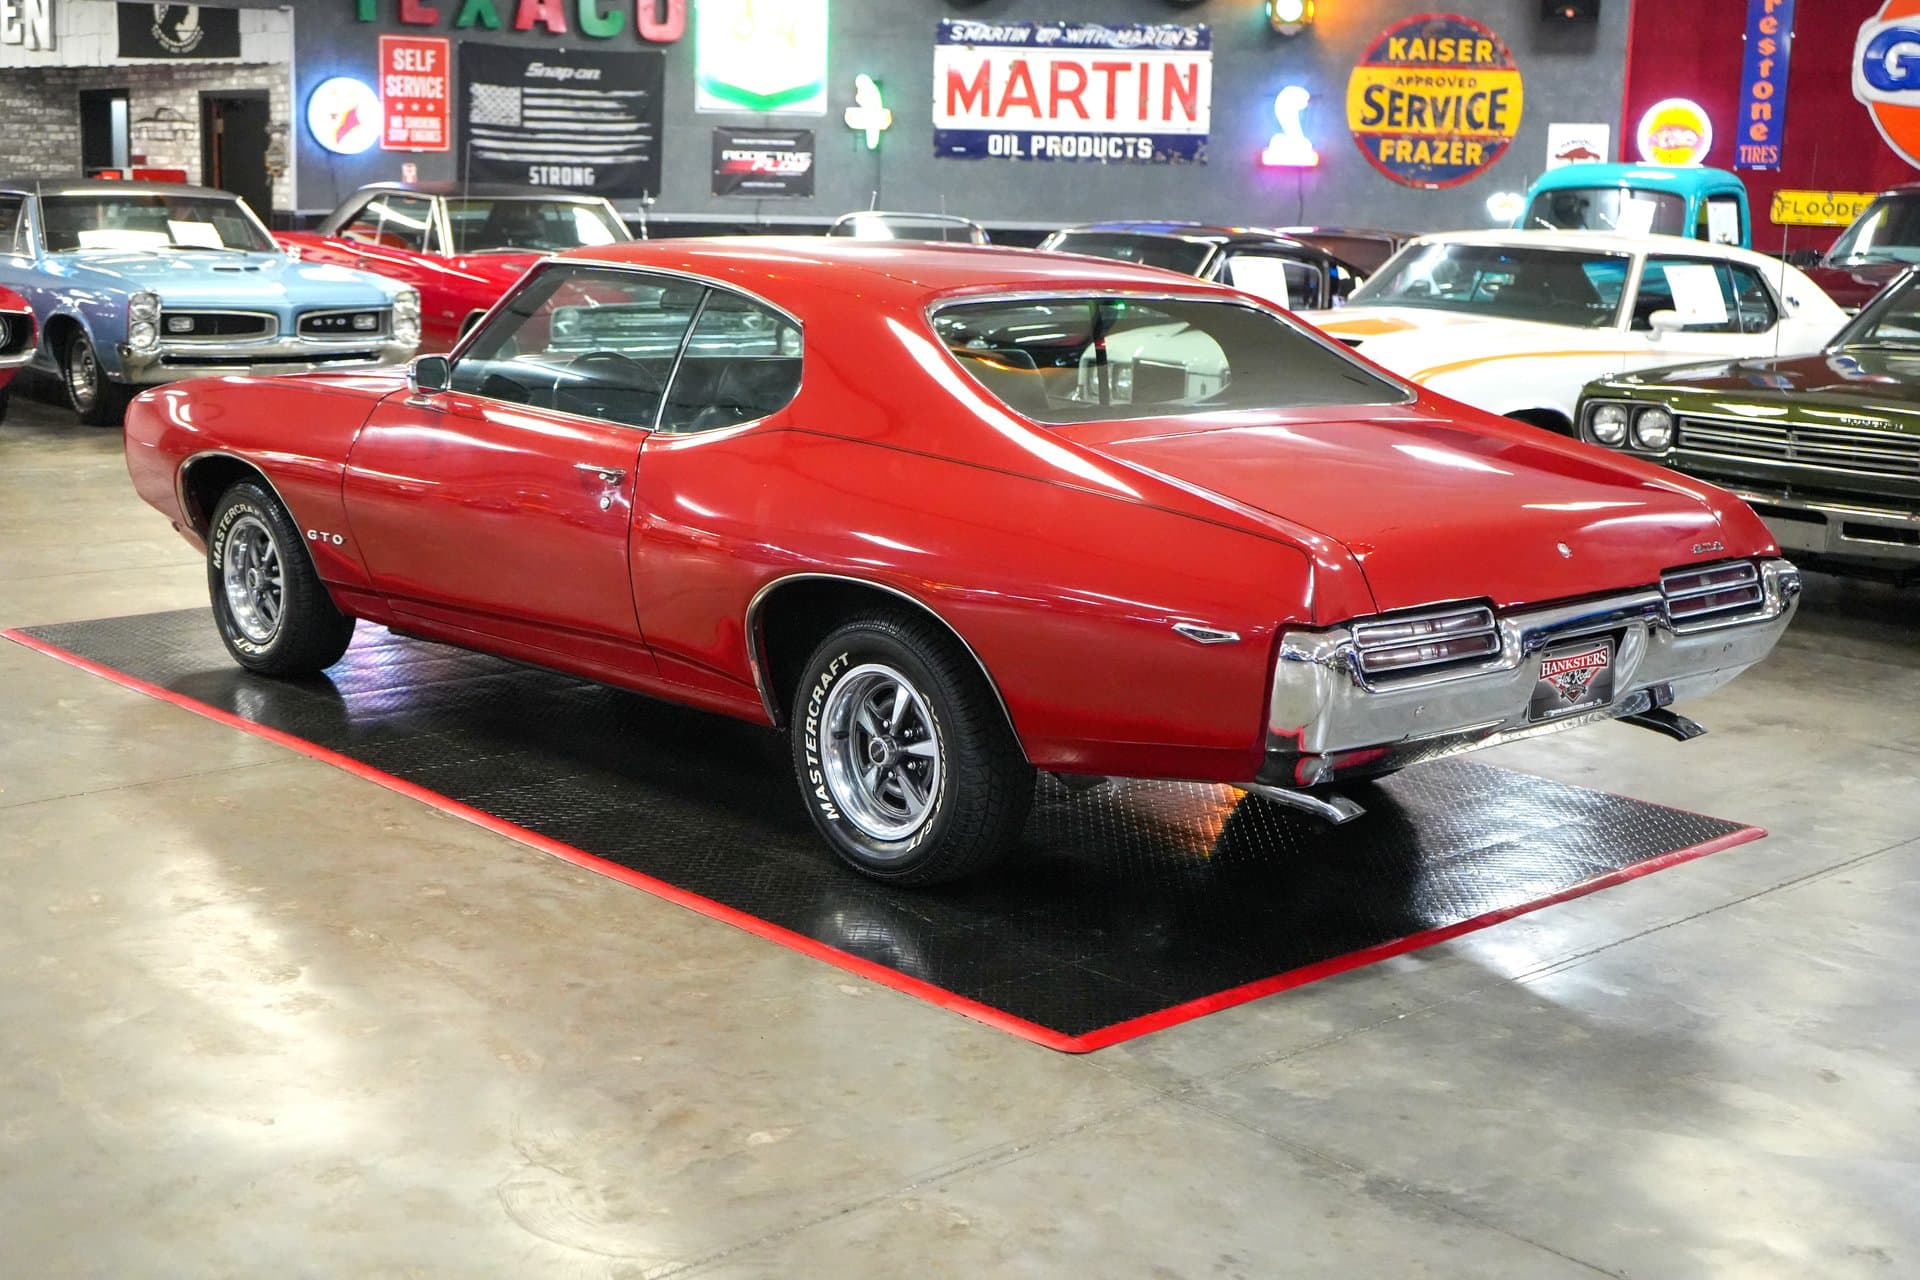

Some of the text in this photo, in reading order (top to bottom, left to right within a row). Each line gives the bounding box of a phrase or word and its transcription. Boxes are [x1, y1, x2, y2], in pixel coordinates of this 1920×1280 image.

[1066, 28, 1108, 44] WITH
[393, 48, 436, 72] SELF
[1388, 37, 1495, 63] KAISER
[525, 62, 602, 81] Snap-on
[1396, 76, 1478, 88] APPROVED
[386, 75, 443, 99] SERVICE
[946, 60, 1199, 121] MARTIN
[1361, 84, 1509, 132] SERVICE
[988, 135, 1154, 159] OIL PRODUCTS
[1380, 139, 1484, 166] FRAZER
[1740, 145, 1778, 164] TIRES
[529, 166, 595, 187] STRONG
[1779, 200, 1871, 217] FLOODE
[307, 530, 344, 545] GTO
[1541, 650, 1607, 677] HANKSTERS
[805, 652, 849, 820] MASTERCRAFT
